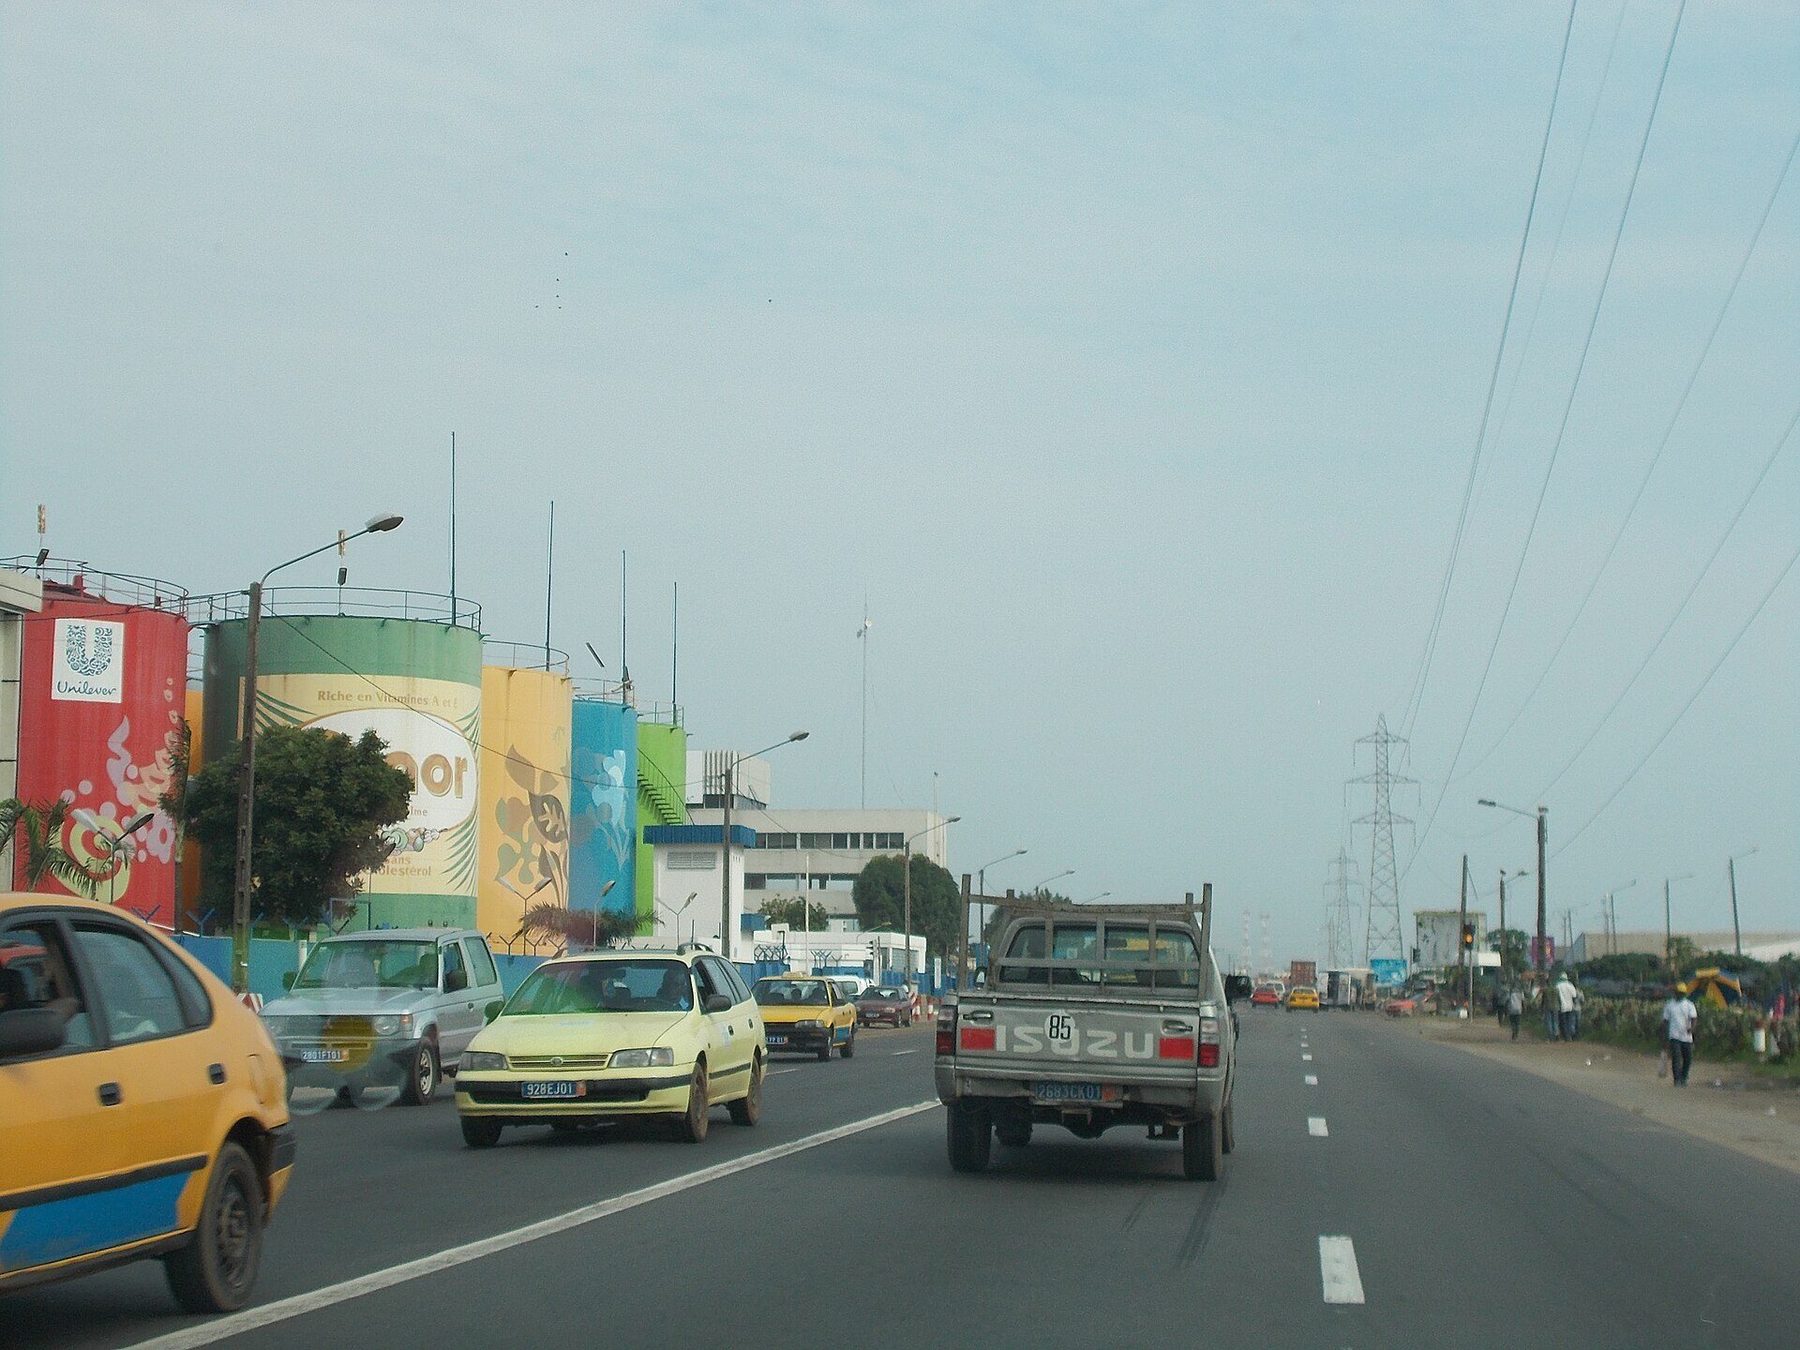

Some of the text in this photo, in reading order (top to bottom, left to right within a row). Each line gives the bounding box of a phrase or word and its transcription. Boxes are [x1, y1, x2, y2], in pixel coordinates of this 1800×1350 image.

[57, 681, 117, 696] Unilever
[318, 690, 353, 701] Riche
[357, 693, 372, 702] en
[378, 865, 431, 877] olestérol
[1049, 1015, 1071, 1040] 85
[996, 1025, 1154, 1059] ISUZU
[527, 1083, 572, 1095] 928EJ01
